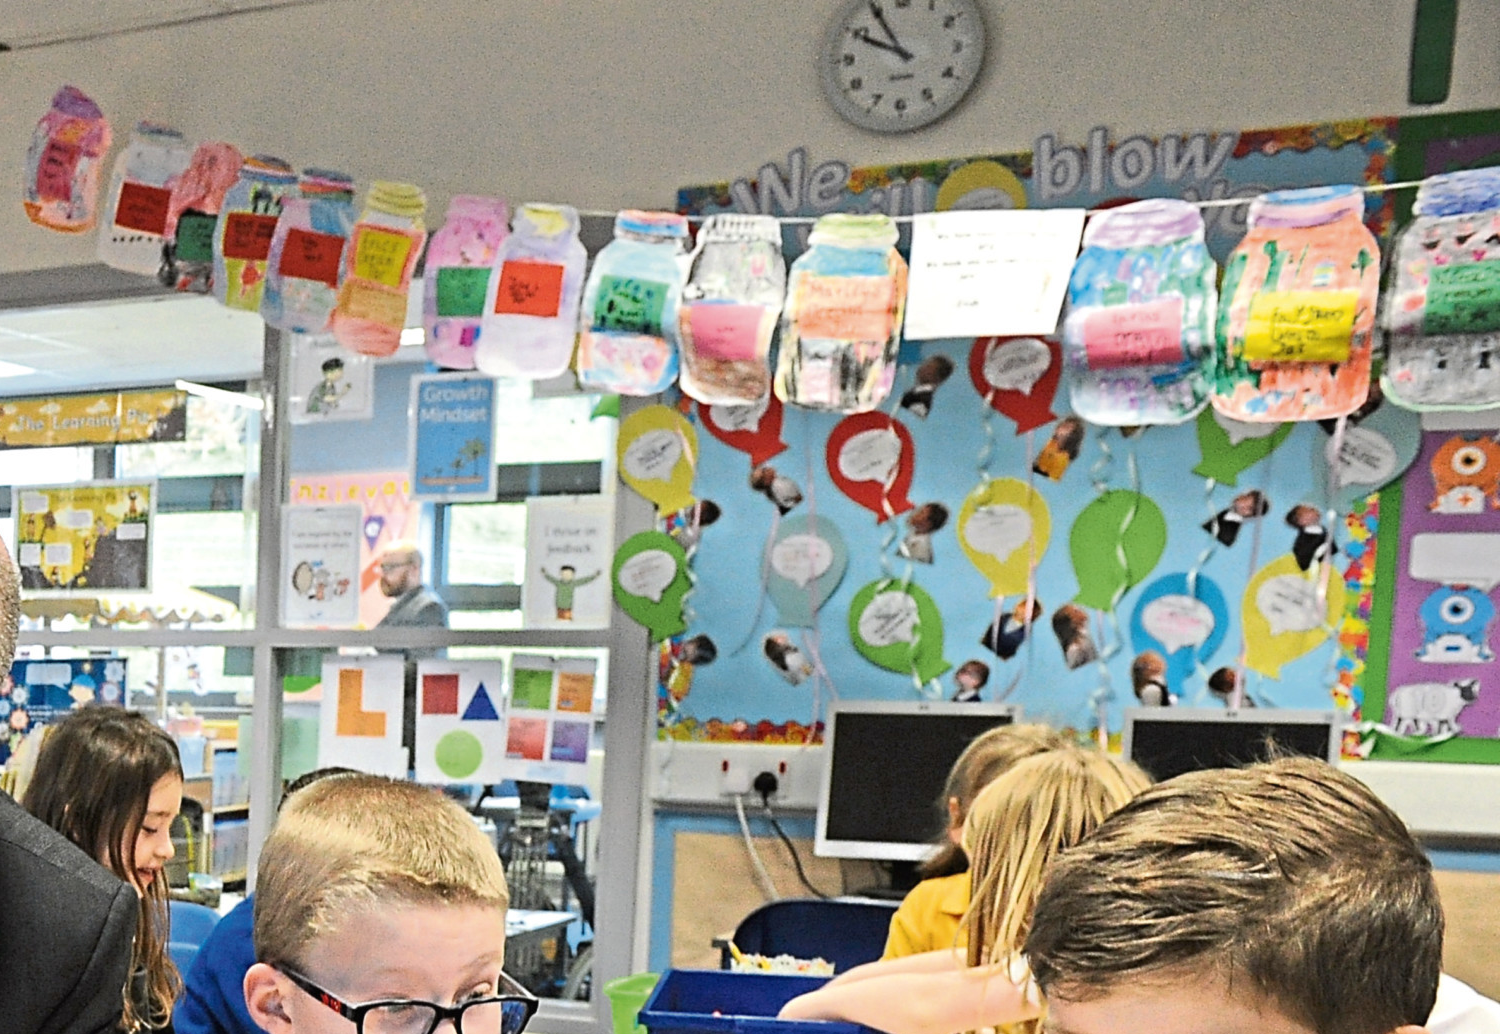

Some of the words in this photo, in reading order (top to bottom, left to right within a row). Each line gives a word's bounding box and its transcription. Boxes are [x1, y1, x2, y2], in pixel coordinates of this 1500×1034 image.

[1031, 127, 1241, 200] blow
[423, 384, 489, 403] Growth
[420, 405, 487, 422] Mindset
[52, 414, 120, 434] Learning
